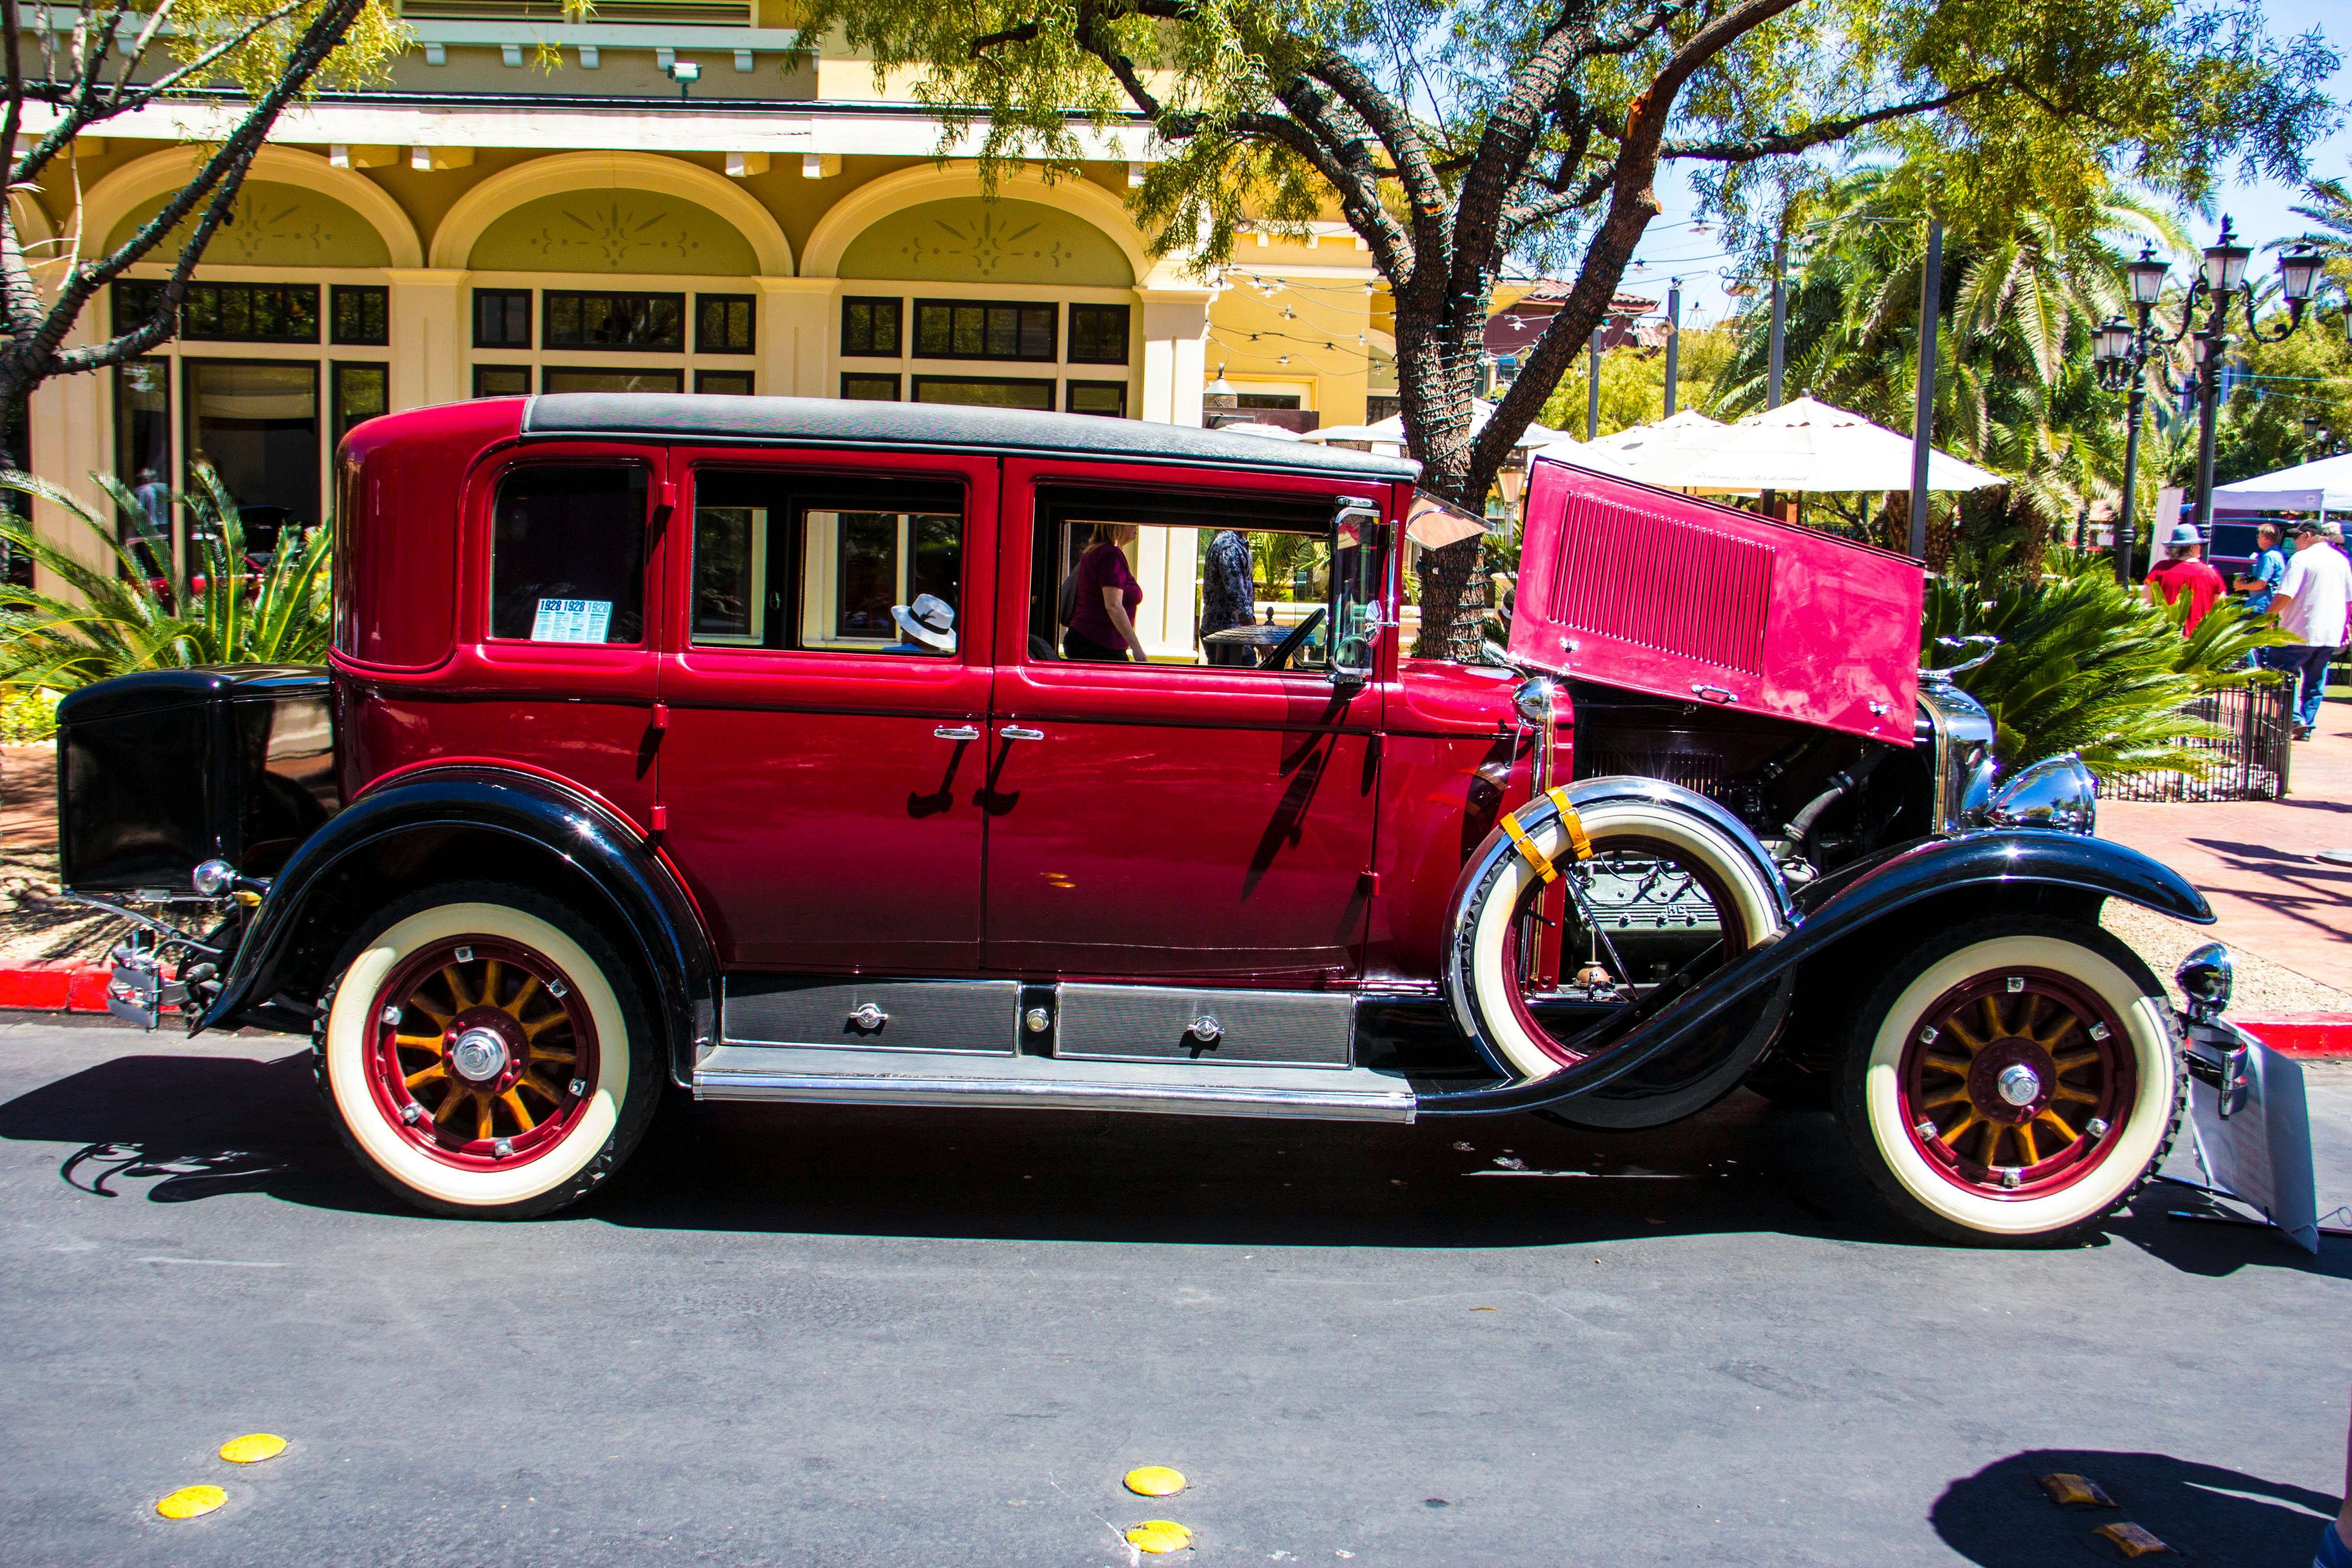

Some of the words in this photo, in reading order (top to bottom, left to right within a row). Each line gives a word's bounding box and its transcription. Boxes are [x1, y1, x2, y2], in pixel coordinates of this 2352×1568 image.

[540, 600, 562, 611] 1928
[564, 601, 585, 612] 1928
[588, 602, 609, 613] 1928
